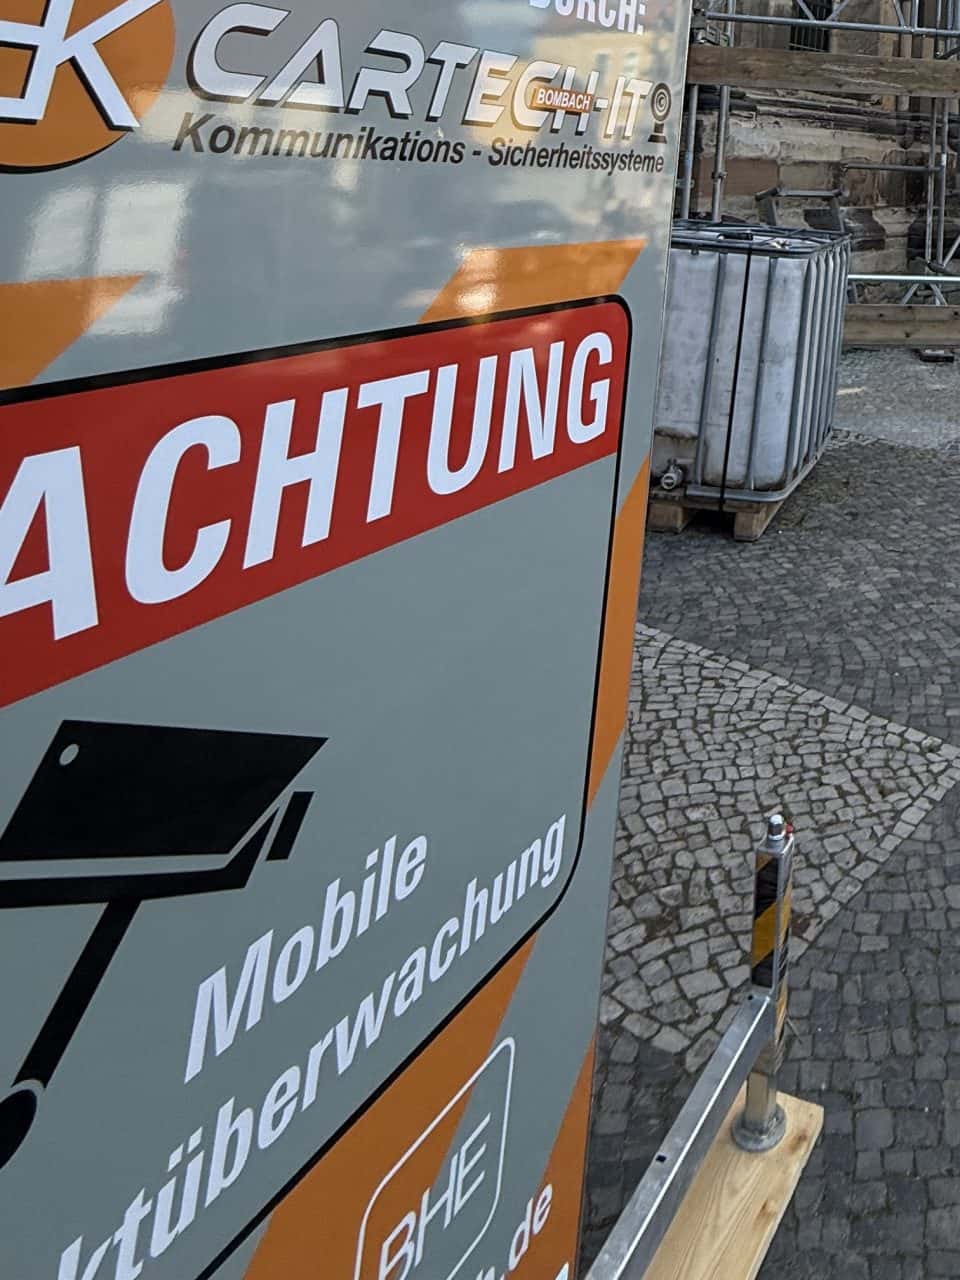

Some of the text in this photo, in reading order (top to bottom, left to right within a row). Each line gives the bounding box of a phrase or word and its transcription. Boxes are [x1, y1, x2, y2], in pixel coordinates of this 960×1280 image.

[172, 111, 467, 164] Kommunikations
[488, 137, 664, 176] Sicherheitssysteme
[537, 88, 592, 111] BOMBACH
[0, 330, 612, 641] ACHTUNG
[184, 835, 428, 1085] Mobile
